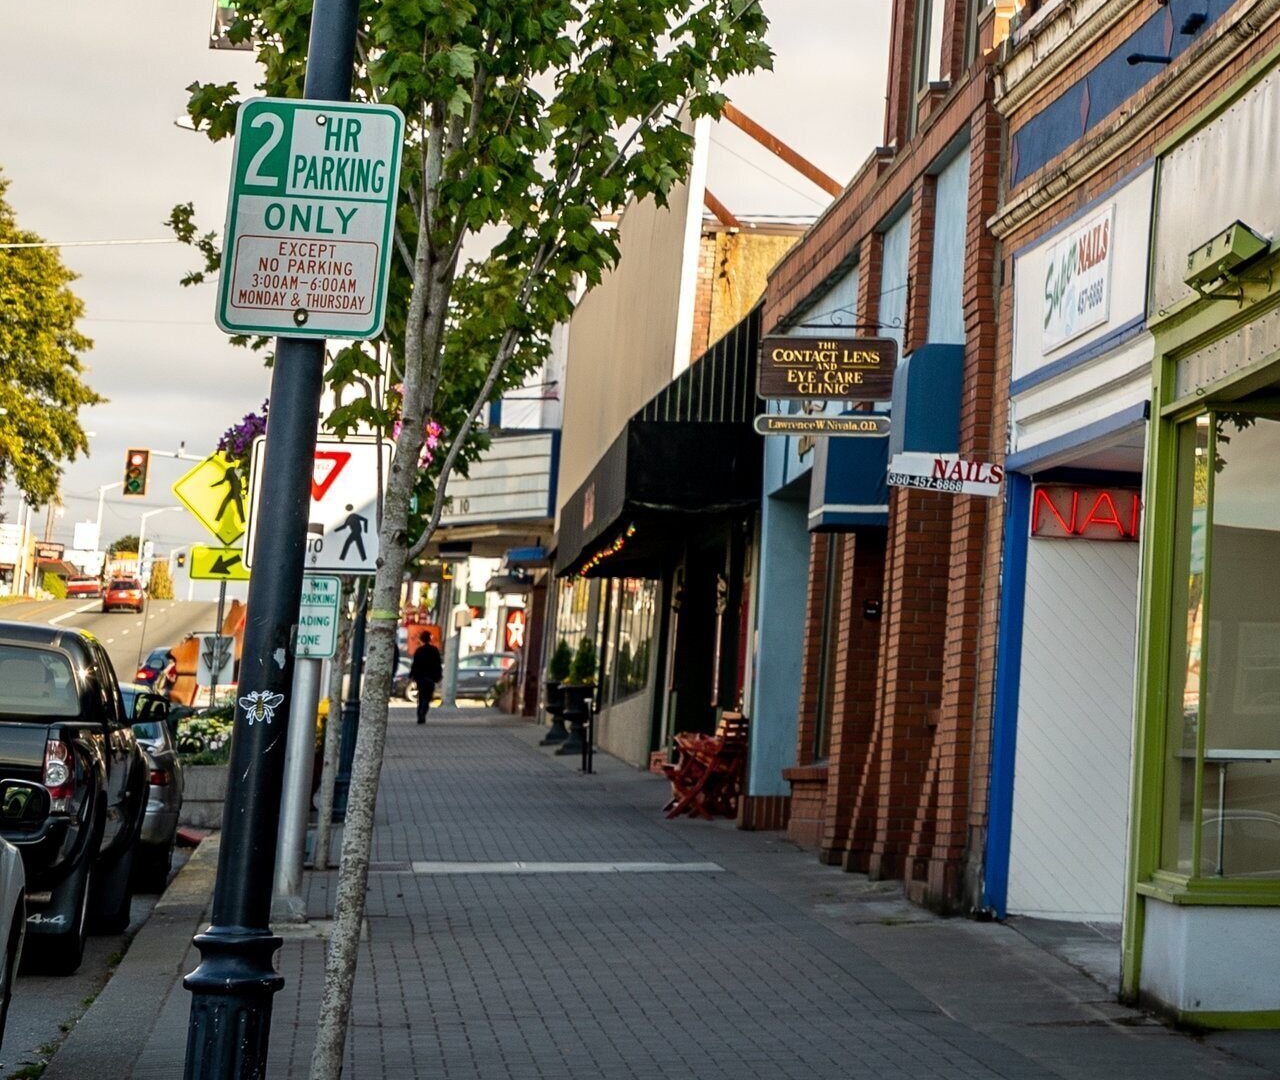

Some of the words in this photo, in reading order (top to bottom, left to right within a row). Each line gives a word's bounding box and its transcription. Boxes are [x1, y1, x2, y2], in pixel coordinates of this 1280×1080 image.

[244, 111, 285, 187] 2
[324, 117, 362, 153] HR
[292, 154, 386, 194] PARKING
[264, 202, 358, 235] ONLY
[279, 241, 337, 259] EXCEPT
[1078, 219, 1109, 276] NAILS
[259, 257, 279, 272] NO
[288, 259, 353, 276] PARKING
[238, 290, 287, 307] MONDAY
[290, 293, 301, 307] &
[306, 293, 366, 310] THURSDAY
[817, 341, 838, 350] THE
[772, 349, 838, 363] CONTACT
[843, 350, 880, 364] LENS
[816, 362, 838, 371] AND
[787, 370, 816, 383] EYE
[824, 371, 863, 384] CARE
[798, 383, 849, 395] CLINIC
[768, 419, 815, 430] Lawrence
[932, 459, 1003, 485] NAILS
[889, 473, 963, 492] 360-457-6868
[307, 538, 323, 553] TO
[302, 594, 335, 604] PARKING
[300, 615, 330, 626] ADING
[26, 913, 67, 925] 4x4
